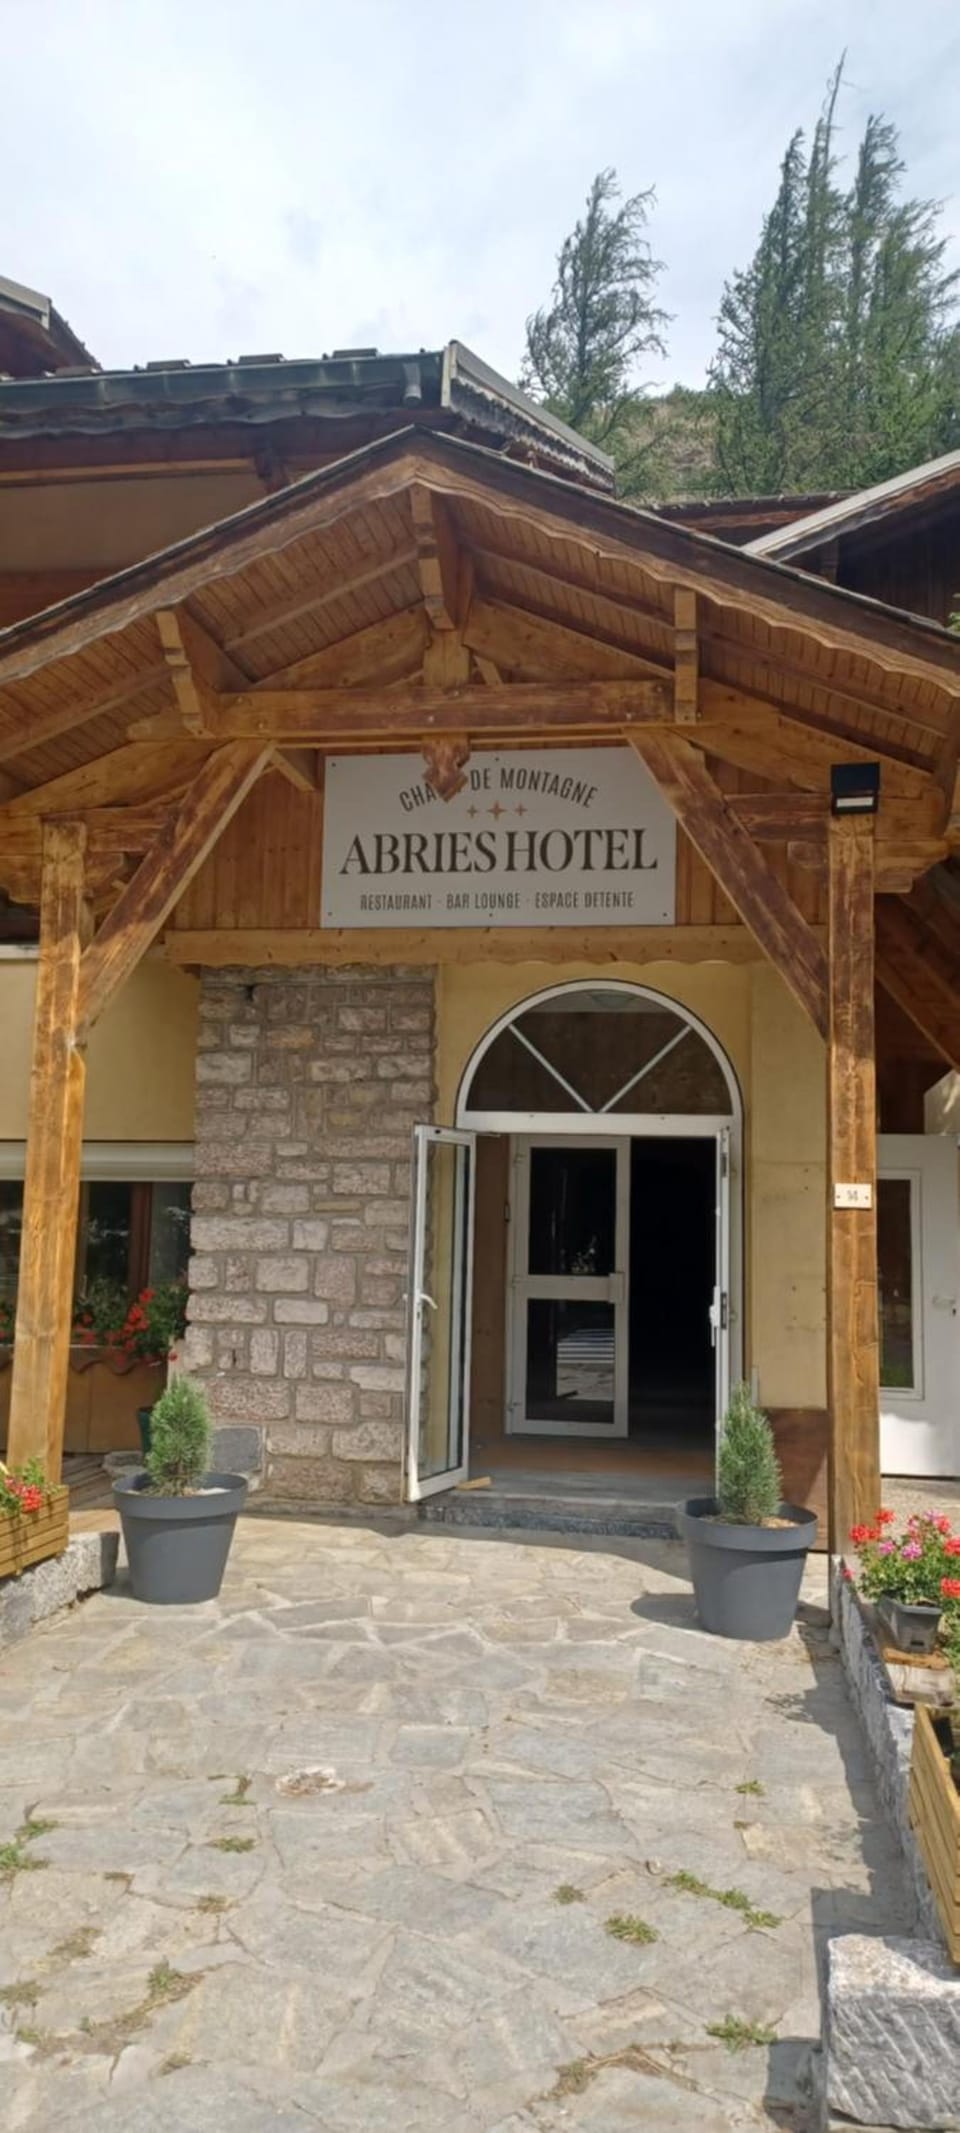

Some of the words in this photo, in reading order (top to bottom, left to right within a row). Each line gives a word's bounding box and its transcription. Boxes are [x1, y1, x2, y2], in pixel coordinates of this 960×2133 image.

[470, 768, 491, 791] DE
[500, 767, 598, 808] MONTAGNE
[338, 831, 497, 875] ABRIES
[504, 828, 658, 872] HOTEL
[360, 894, 432, 911] RESTAURANT
[446, 893, 470, 909] BAR
[475, 892, 521, 909] LOUNGE
[535, 891, 579, 908] ESPACE
[584, 891, 634, 908] DETENTE
